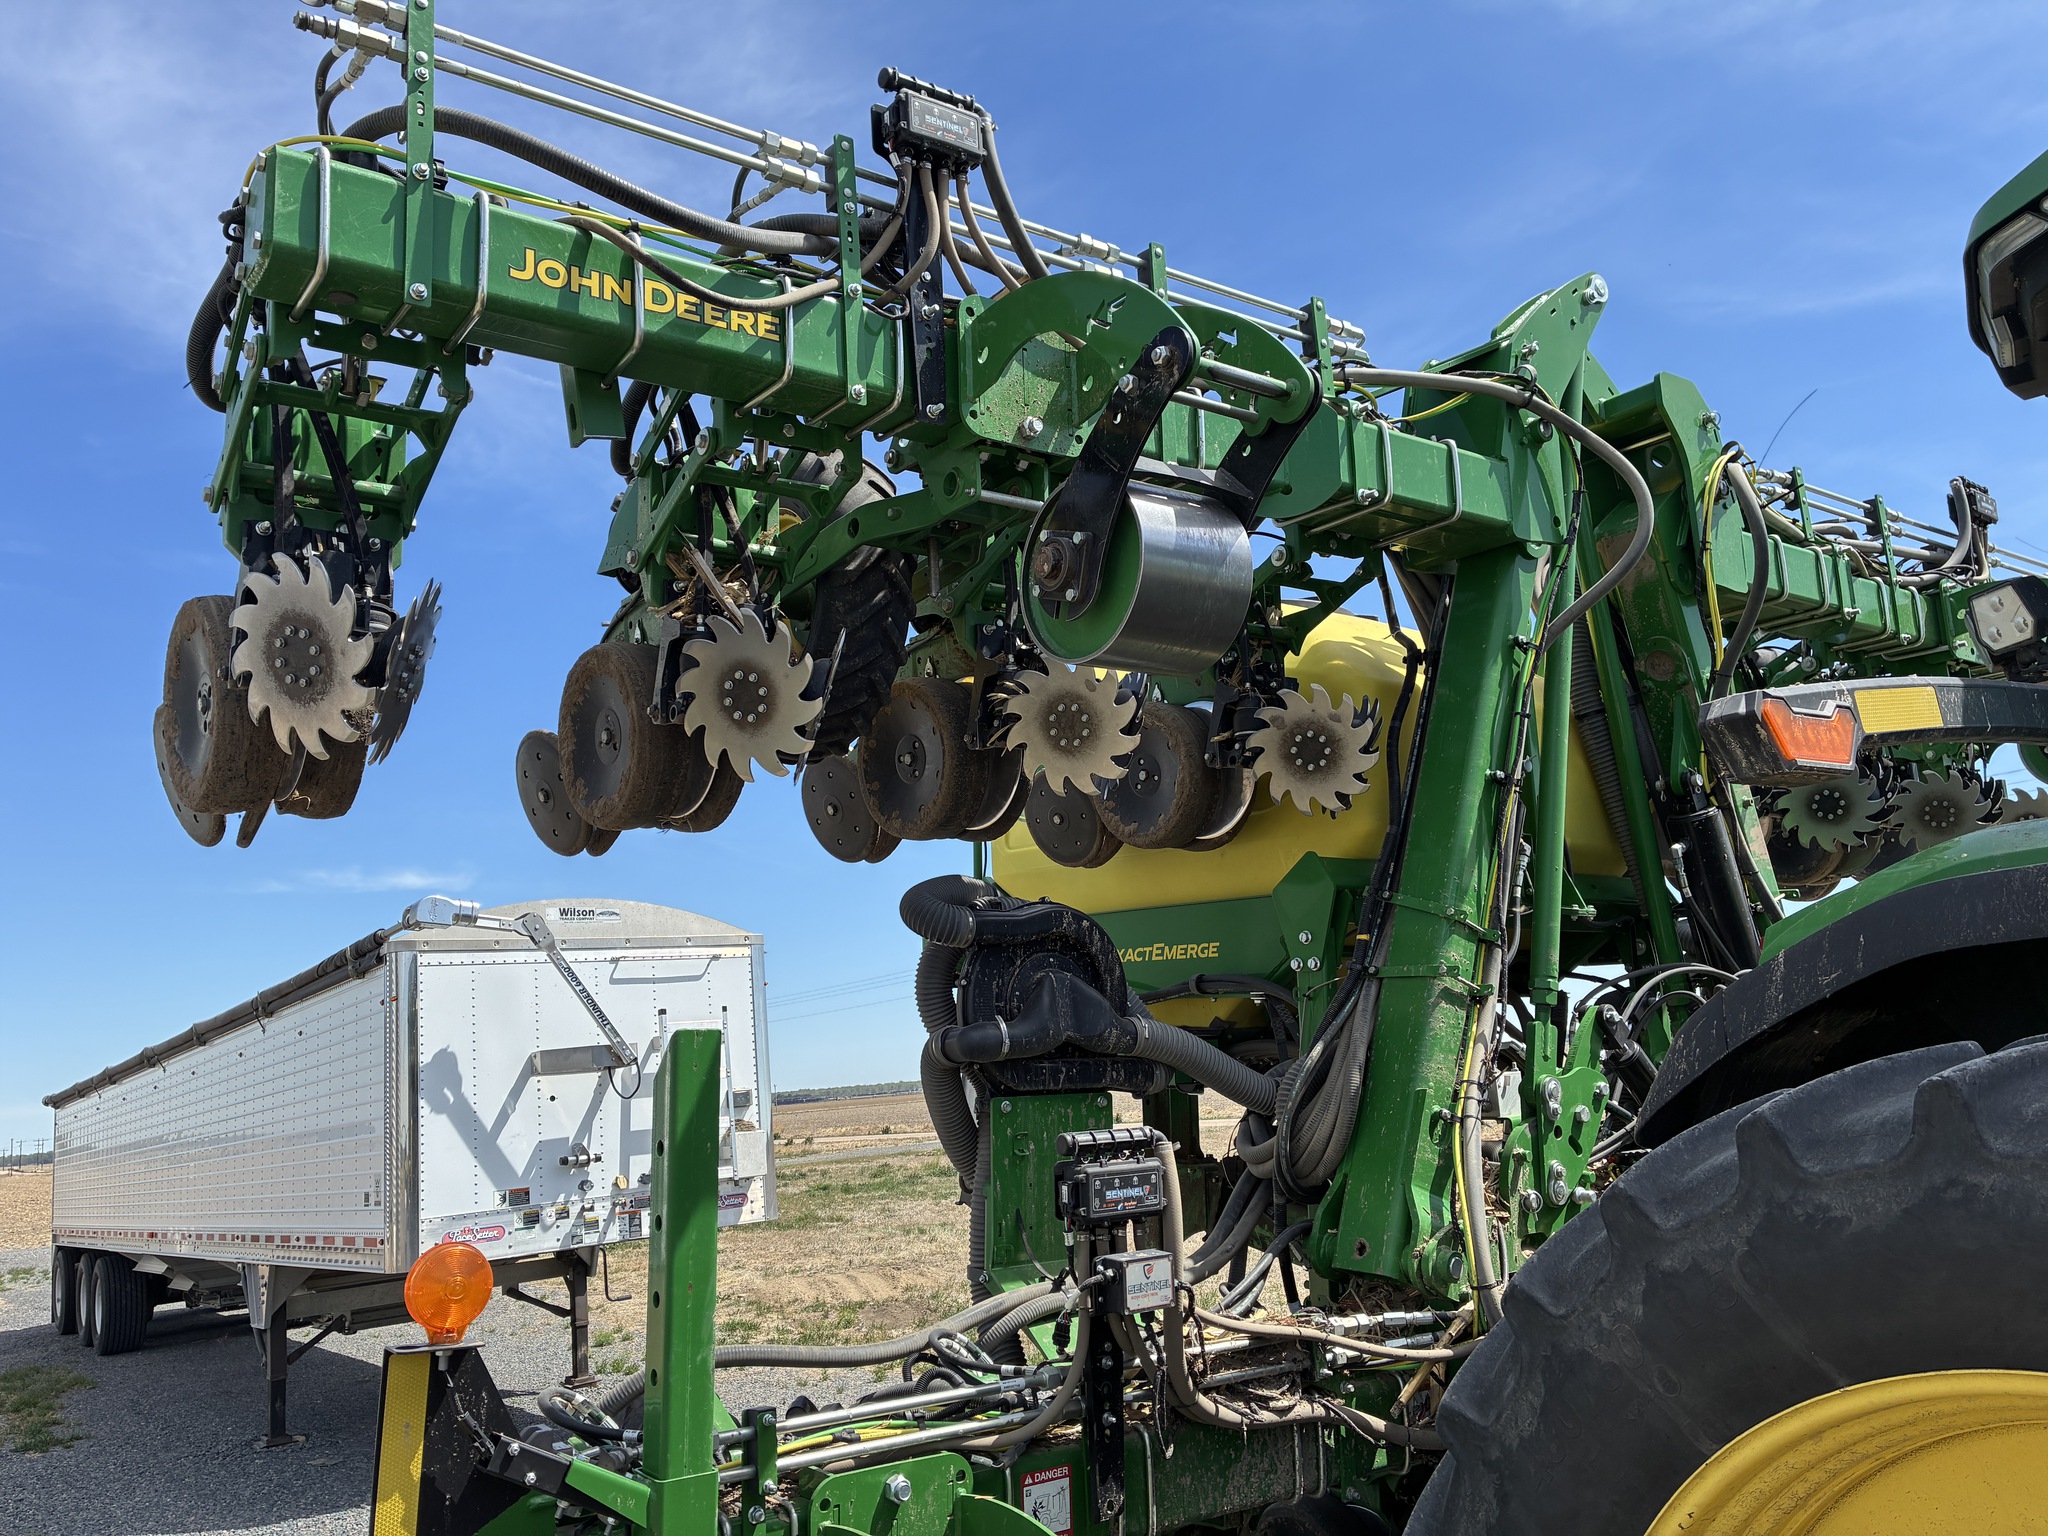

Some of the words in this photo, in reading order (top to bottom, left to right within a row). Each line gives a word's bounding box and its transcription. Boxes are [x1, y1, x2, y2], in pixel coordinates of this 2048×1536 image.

[925, 114, 963, 134] SENTINEL
[508, 247, 633, 306] JOHN
[643, 278, 781, 342] DEERE
[558, 907, 595, 917] Wilson
[1116, 942, 1220, 963] XACTEMERGE
[563, 965, 582, 987] 6000
[579, 986, 610, 1028] THUNDER
[1105, 1187, 1144, 1200] SENTINEL
[449, 1228, 500, 1242] PaceSetter
[1128, 1279, 1171, 1295] SENTINEL
[1034, 1466, 1069, 1482] DANGER
